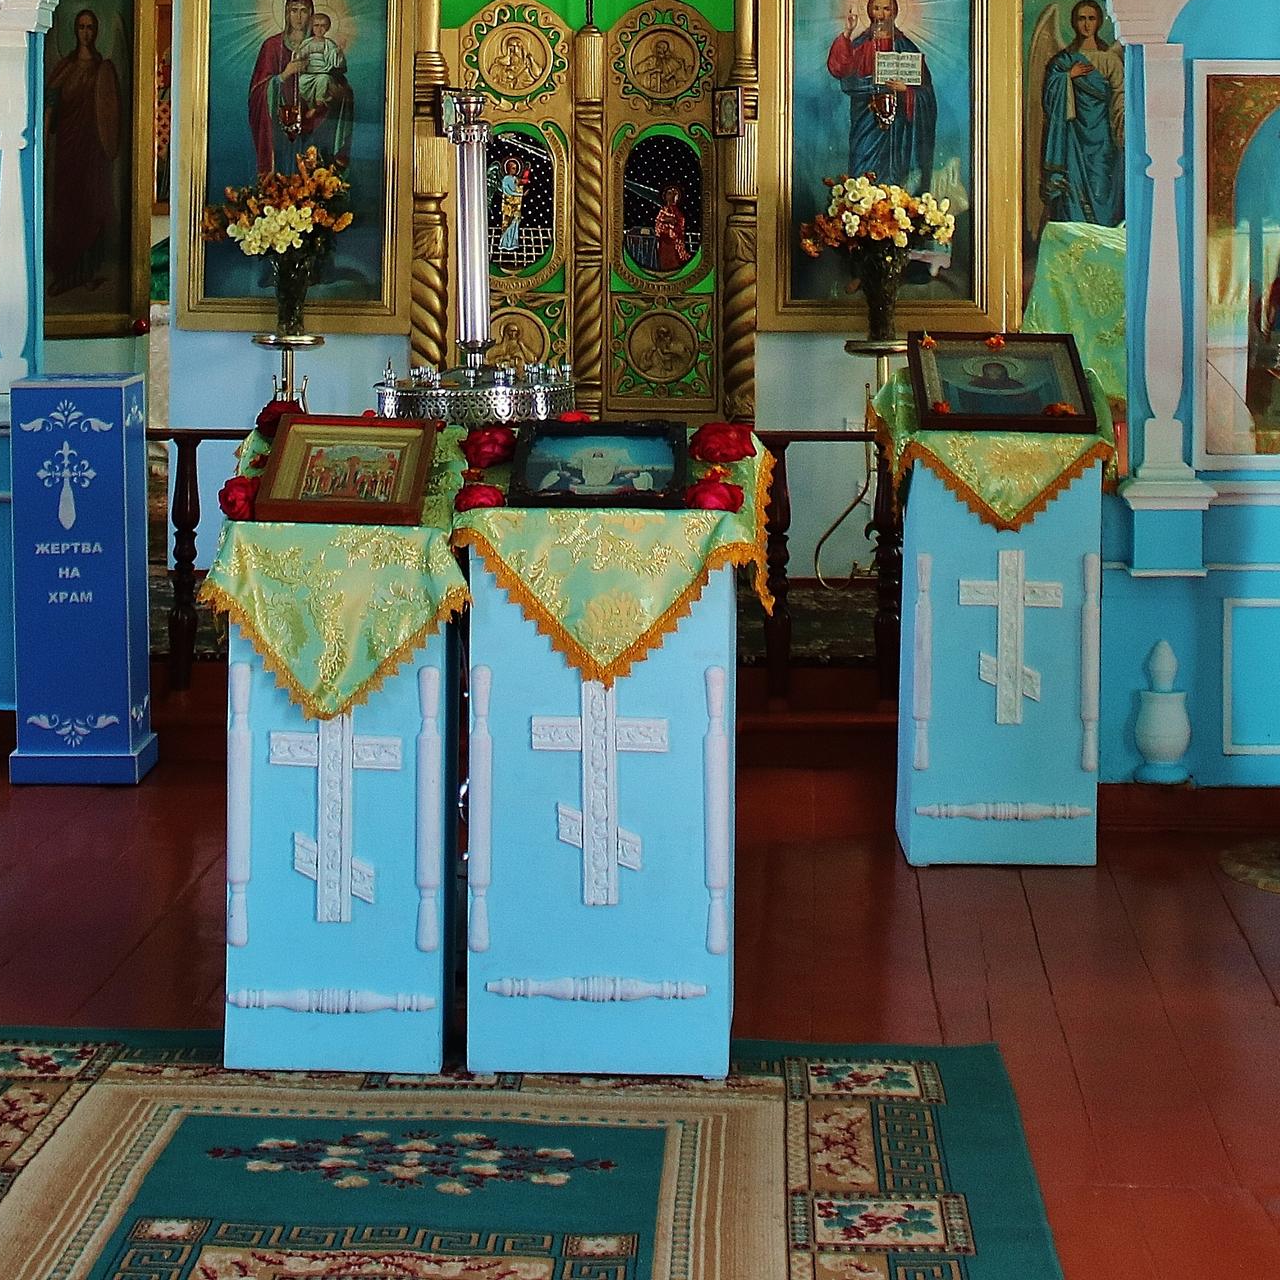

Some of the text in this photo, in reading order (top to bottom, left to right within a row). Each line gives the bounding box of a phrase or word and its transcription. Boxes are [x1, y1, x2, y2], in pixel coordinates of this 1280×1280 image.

[34, 541, 103, 556] ЖЕРТВА
[58, 566, 81, 580] НА
[47, 590, 93, 605] ХРАМ
